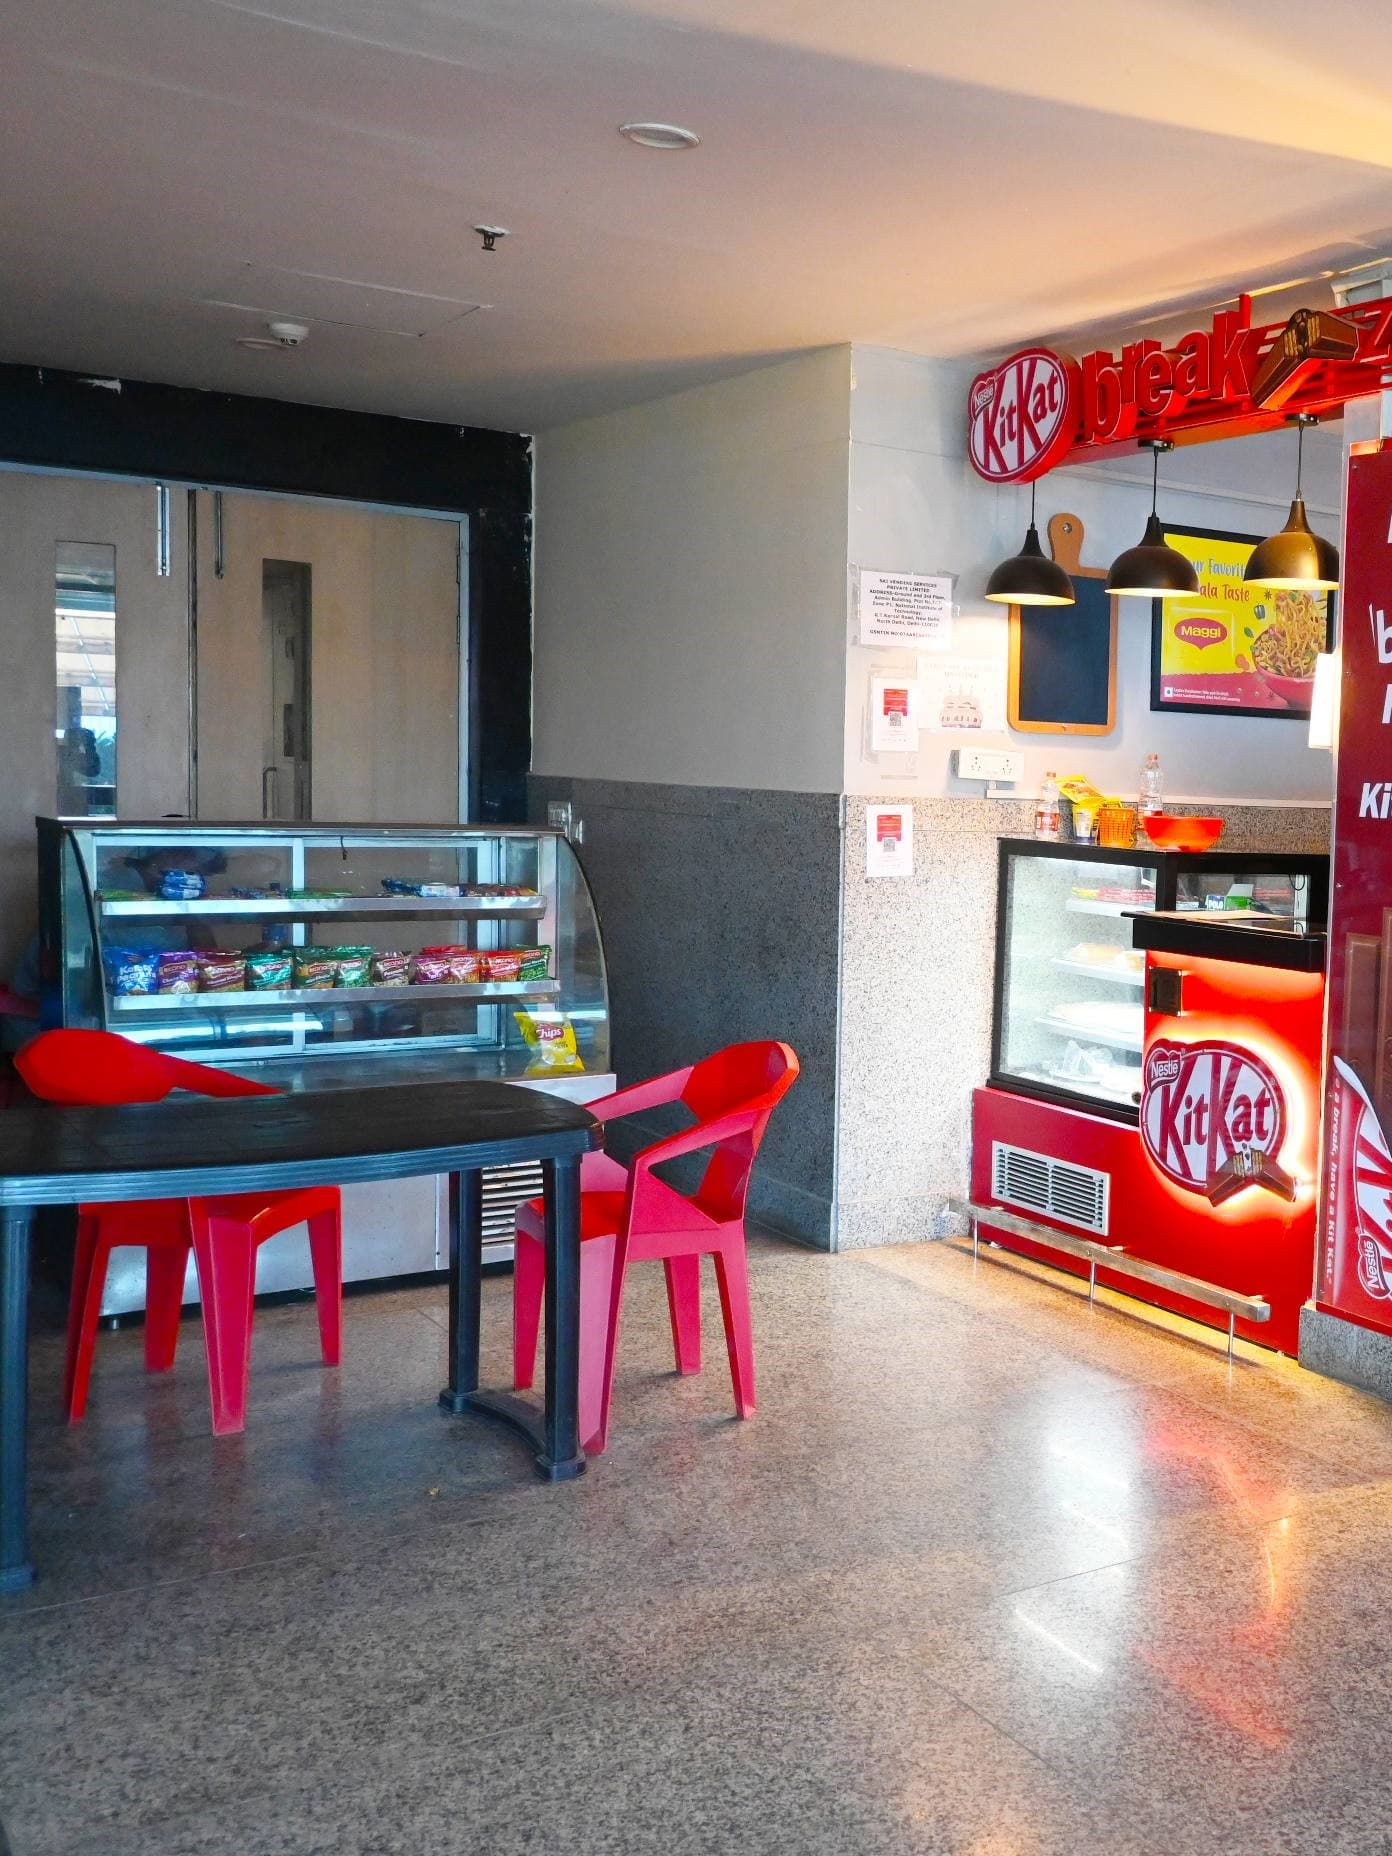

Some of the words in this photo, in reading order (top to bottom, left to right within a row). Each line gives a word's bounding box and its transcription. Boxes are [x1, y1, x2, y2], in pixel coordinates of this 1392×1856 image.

[1083, 311, 1251, 440] break
[1200, 582, 1218, 600] ala
[1222, 584, 1250, 603] Taste
[1181, 625, 1221, 639] Maggi
[1158, 1053, 1272, 1181] KitKat
